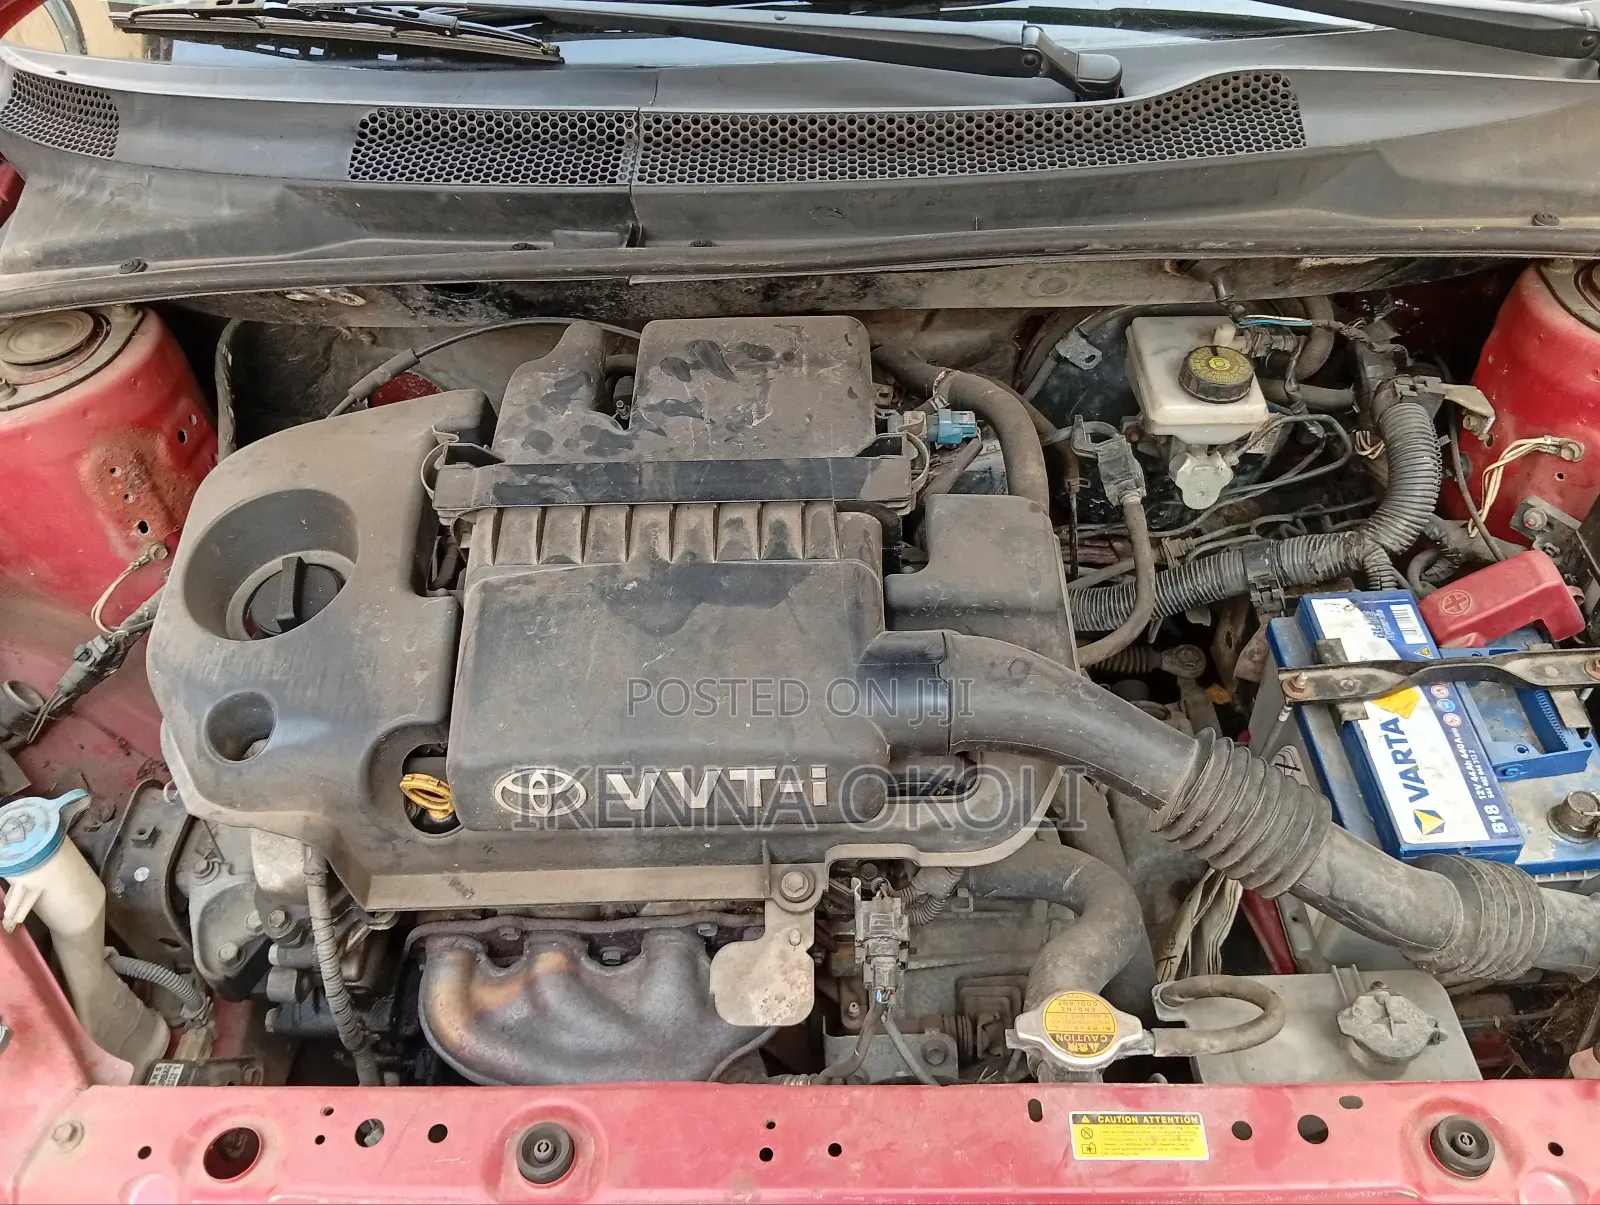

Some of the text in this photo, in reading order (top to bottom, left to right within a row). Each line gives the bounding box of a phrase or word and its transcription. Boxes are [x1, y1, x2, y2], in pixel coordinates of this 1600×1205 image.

[1379, 717, 1429, 804] VARTA
[1464, 760, 1479, 783] 44Ah
[605, 765, 828, 811] VVT-i
[1473, 783, 1487, 800] 12V
[1483, 804, 1509, 834] B18
[1056, 1033, 1108, 1043] CAUTION
[1097, 1115, 1199, 1124] CAUTION ATTENTION
